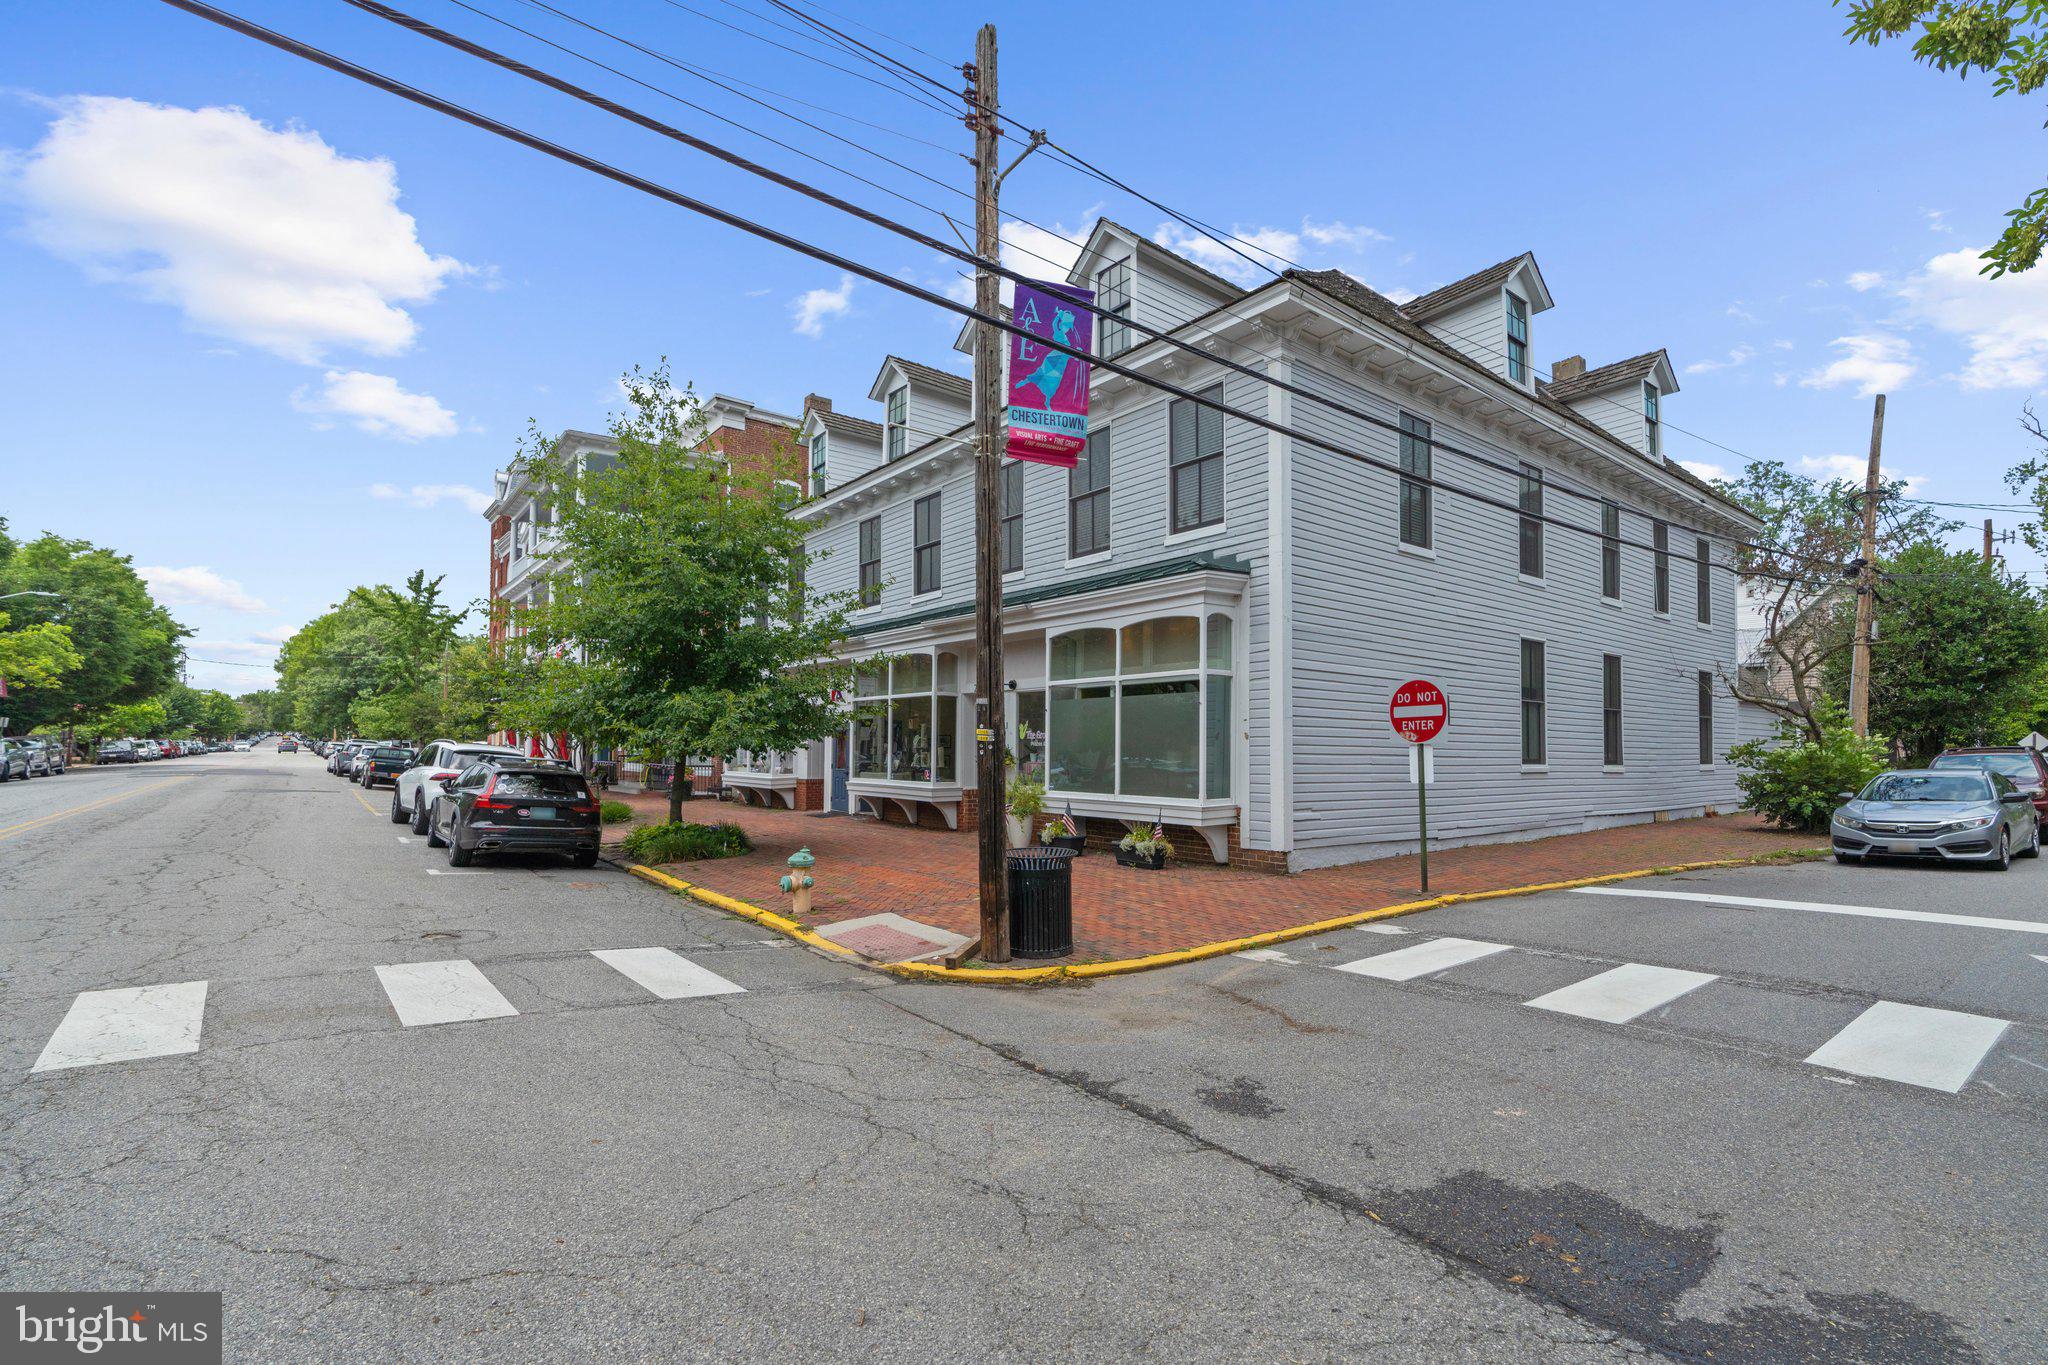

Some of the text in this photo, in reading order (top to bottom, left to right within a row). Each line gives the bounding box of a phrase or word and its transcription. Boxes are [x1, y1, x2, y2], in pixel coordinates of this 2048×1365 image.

[1011, 409, 1085, 431] CHESTERTOWN
[1015, 430, 1080, 448] VISUAL ARTS FINE CRAFT
[1397, 691, 1437, 703] DO NOT
[1402, 720, 1434, 731] ENTER
